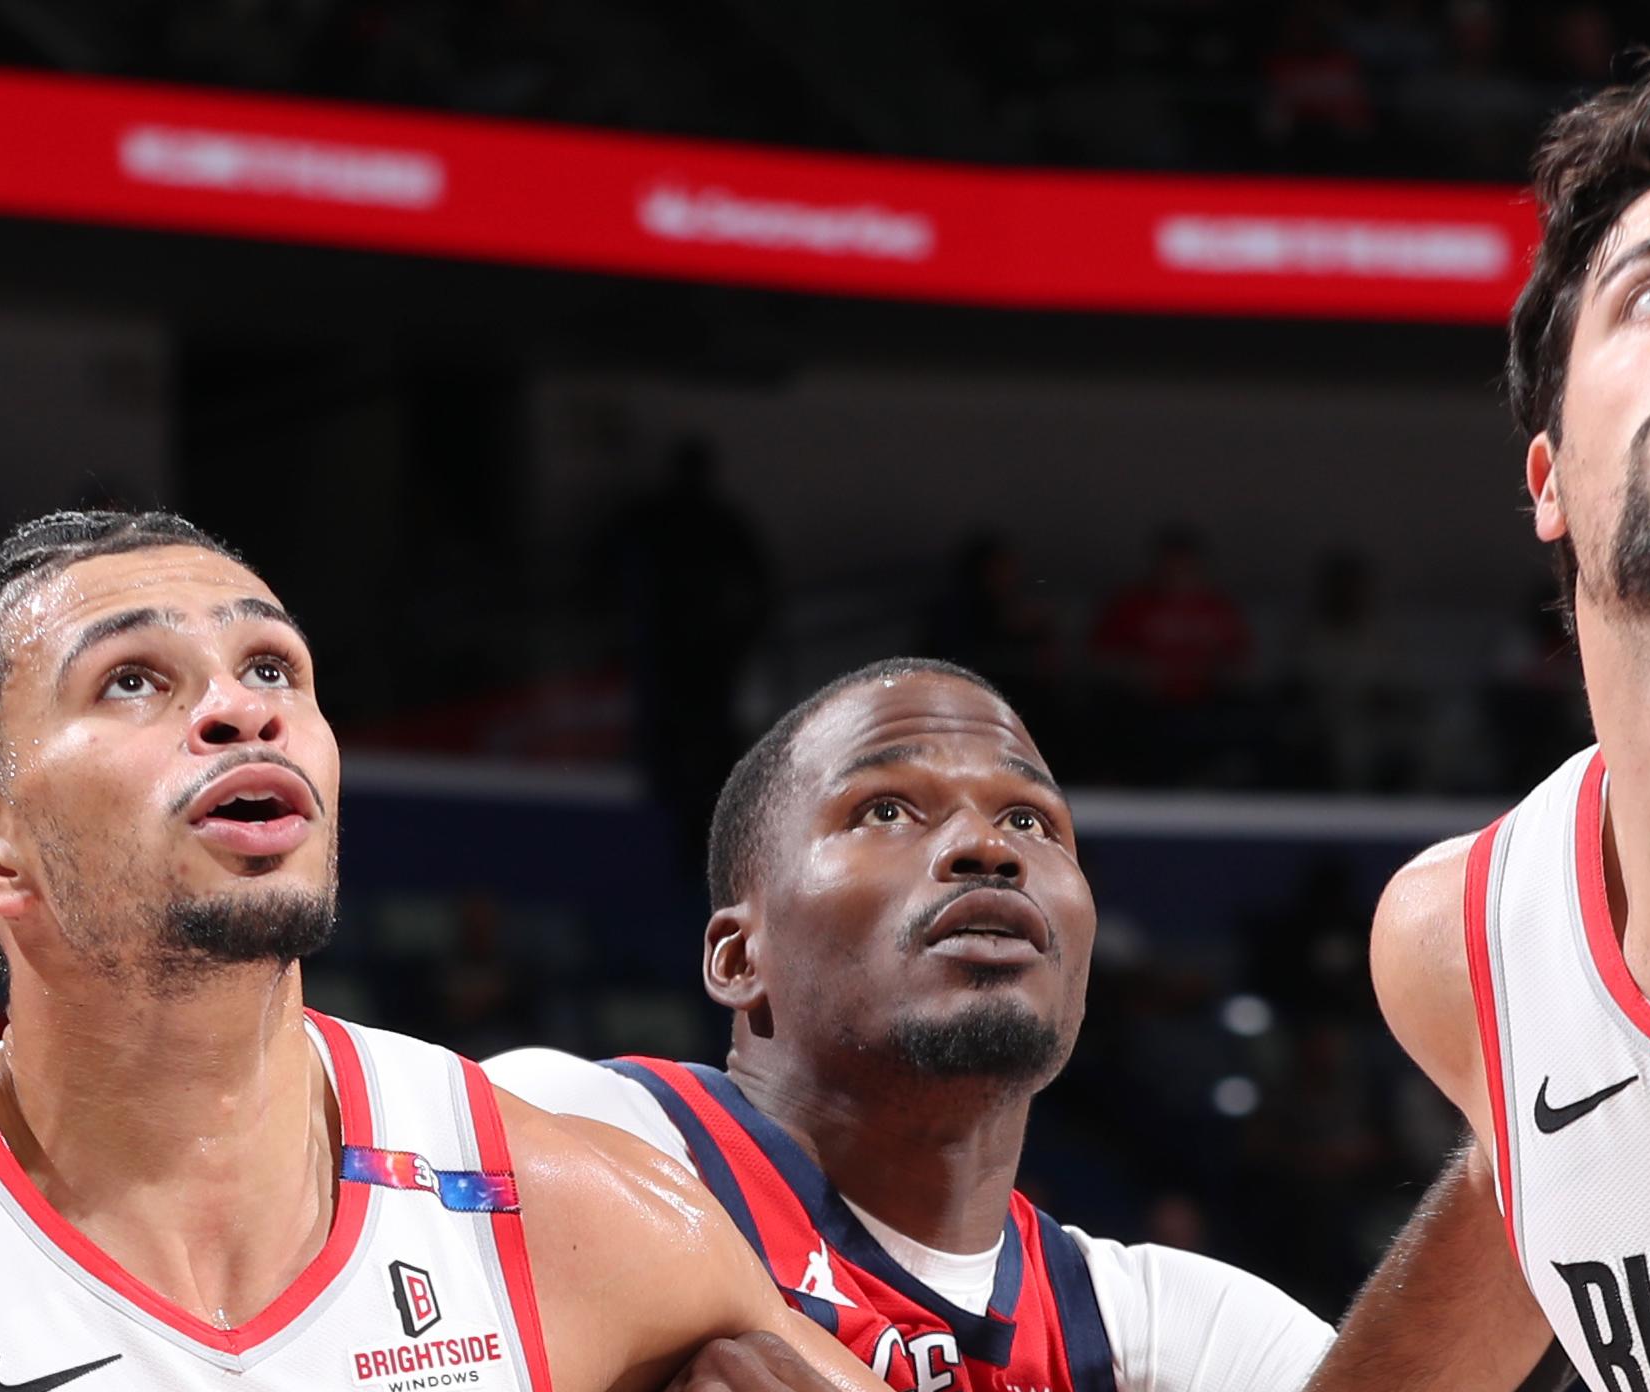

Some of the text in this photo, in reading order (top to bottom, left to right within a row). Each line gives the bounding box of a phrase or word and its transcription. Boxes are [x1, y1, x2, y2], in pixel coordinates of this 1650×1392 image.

[407, 1276, 432, 1321] B
[354, 1333, 502, 1380] BRIGHTSIDE
[389, 1371, 480, 1392] WINDOWS
